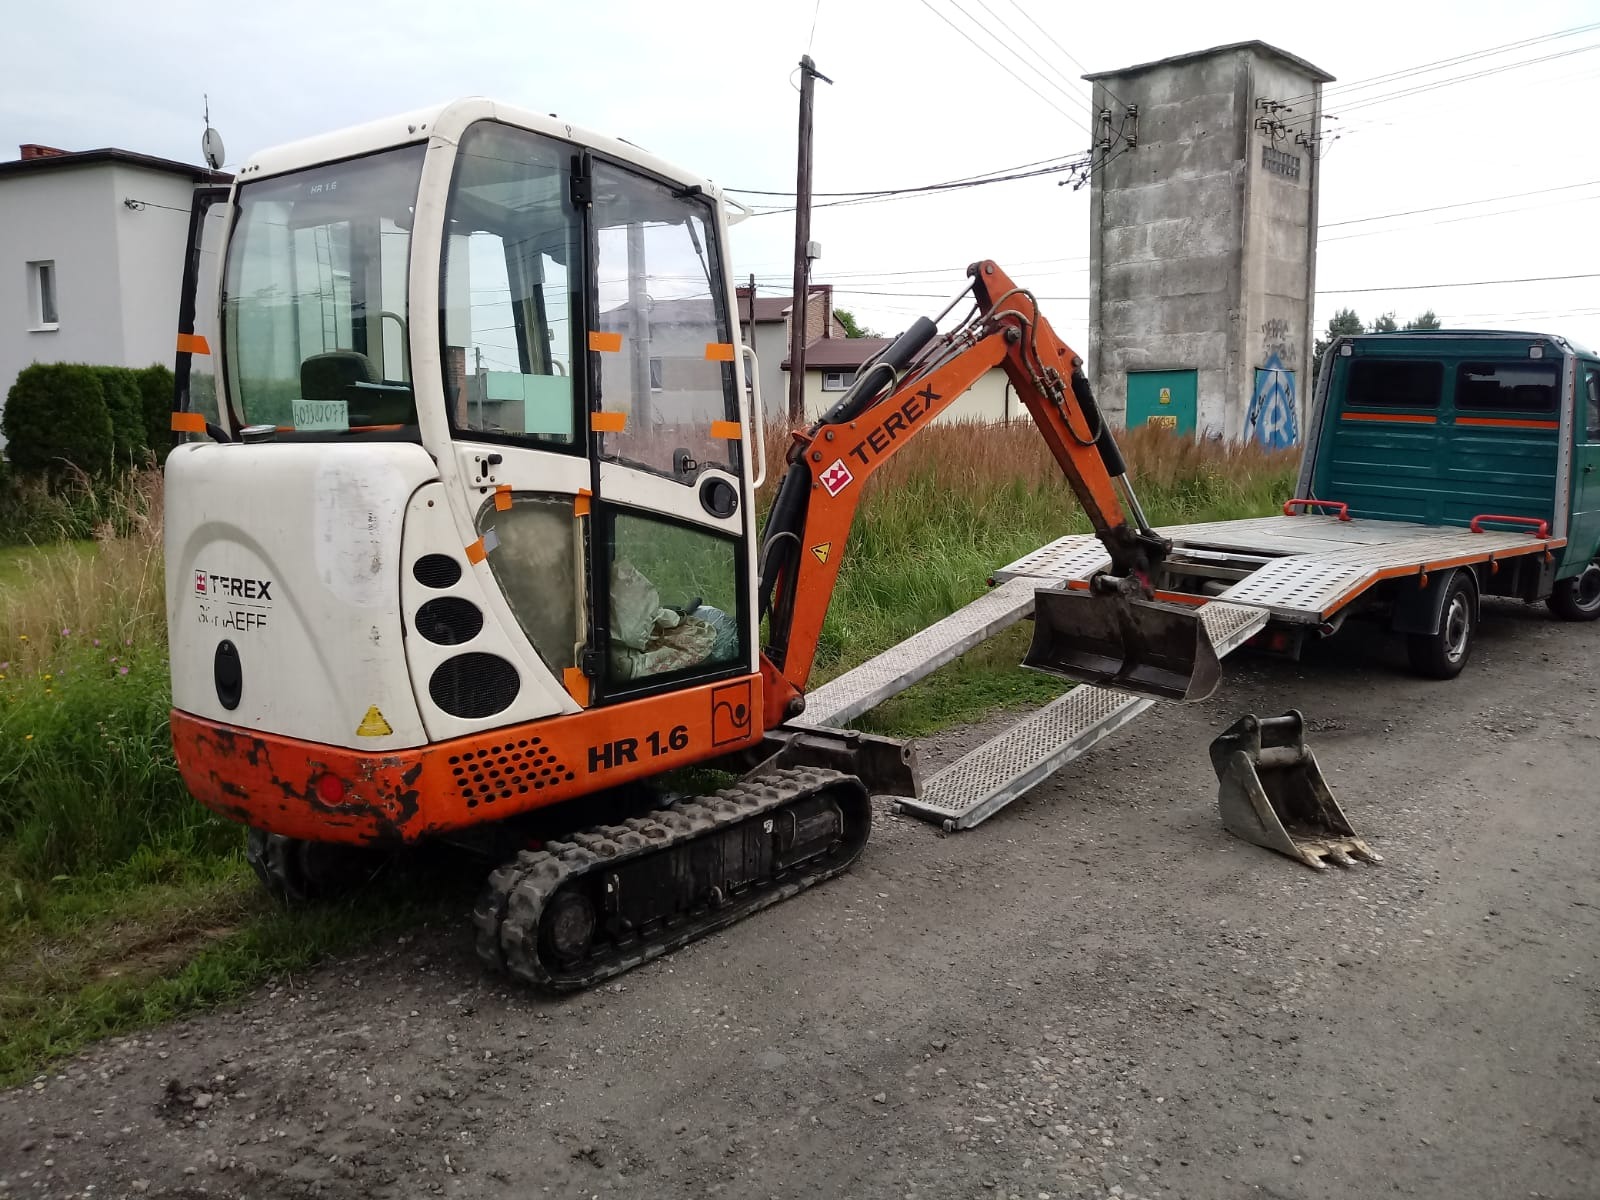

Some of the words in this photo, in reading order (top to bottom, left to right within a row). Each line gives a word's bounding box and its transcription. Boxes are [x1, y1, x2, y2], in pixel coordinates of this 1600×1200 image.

[849, 383, 942, 465] TEREX
[587, 738, 638, 773] HR
[646, 725, 689, 757] 1.6
